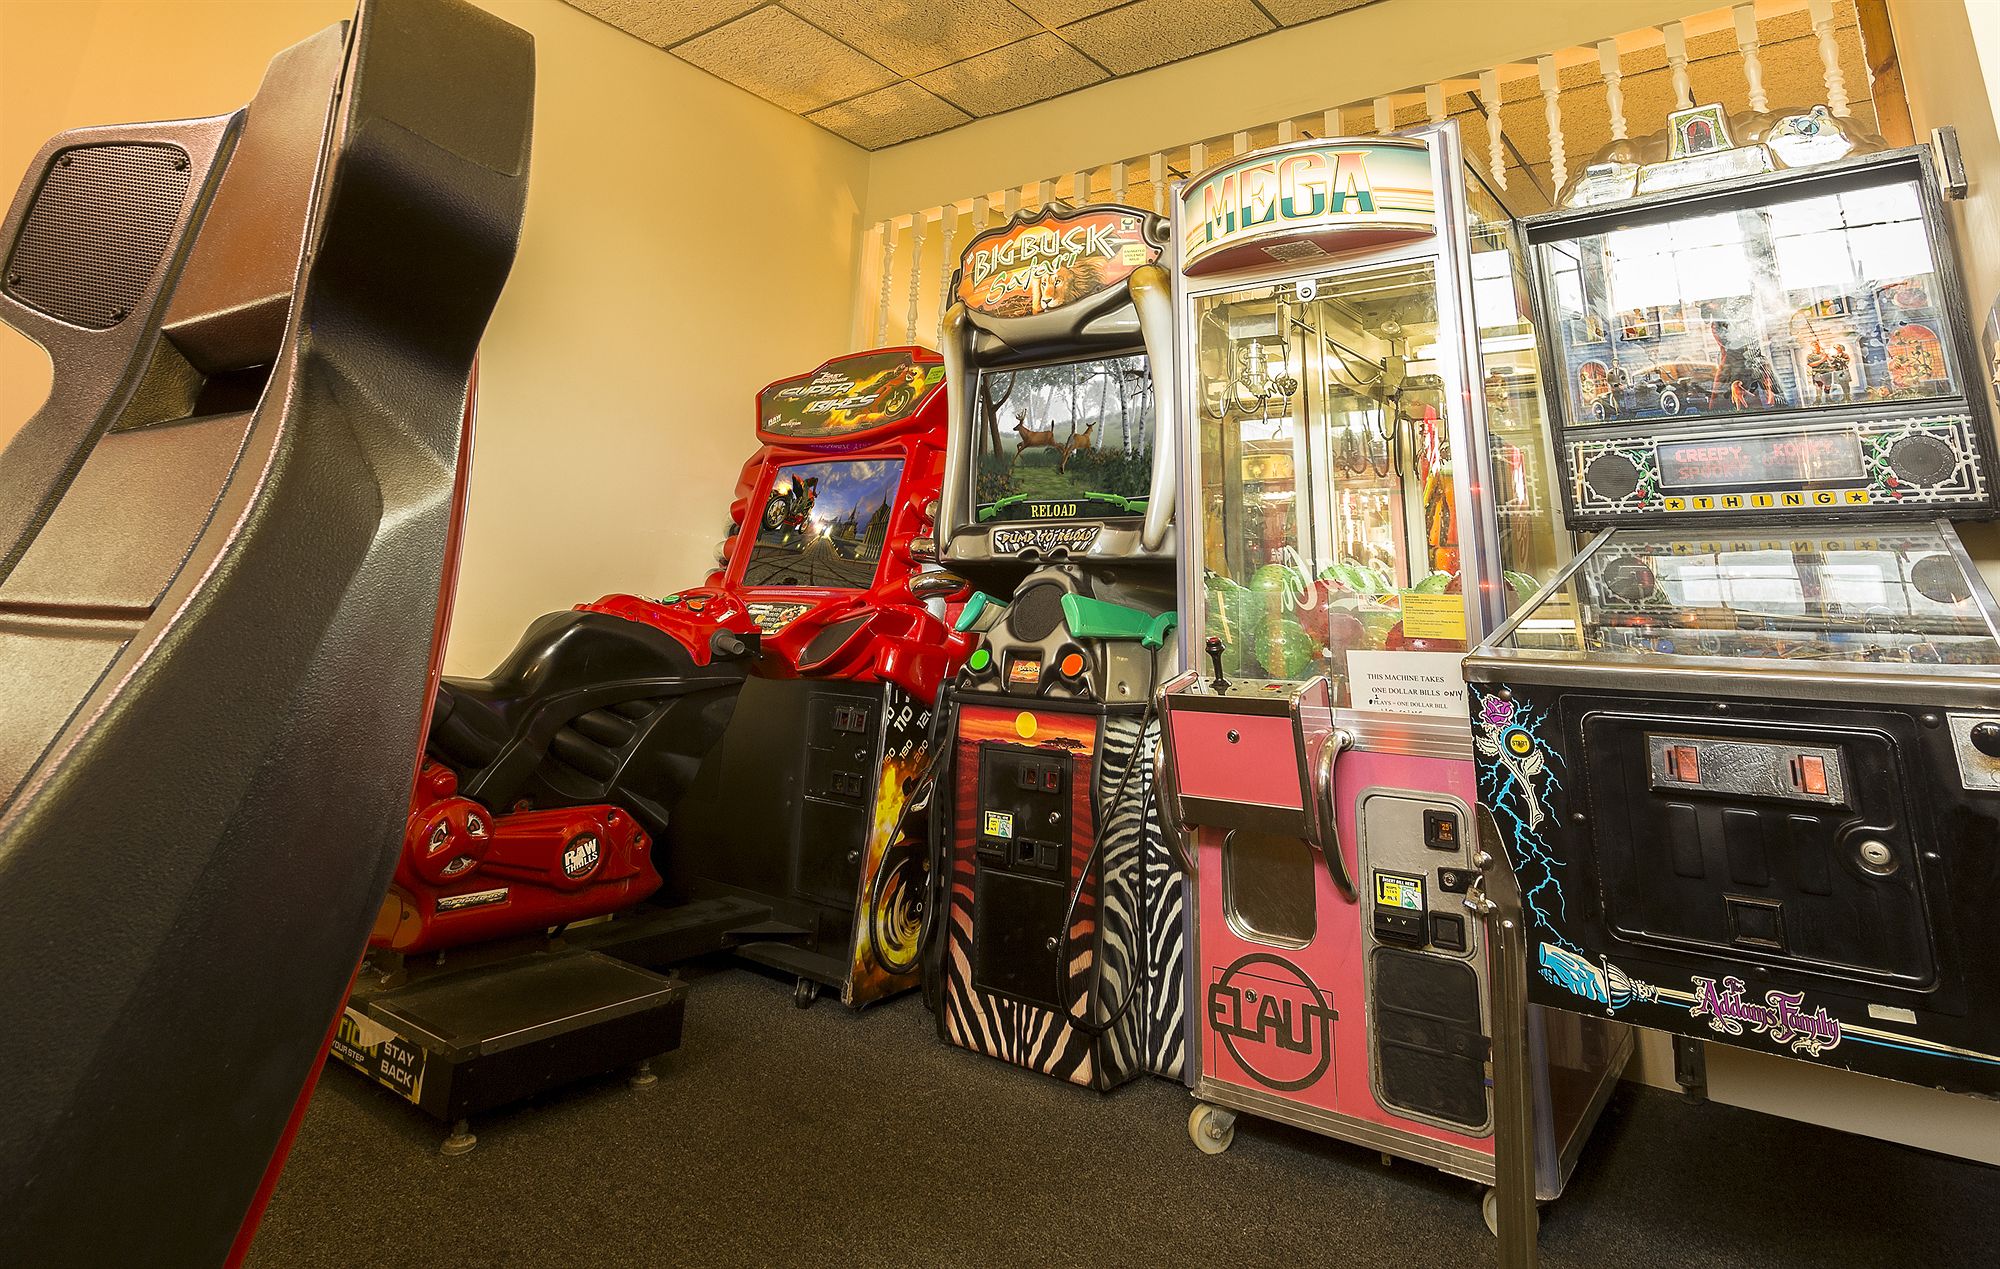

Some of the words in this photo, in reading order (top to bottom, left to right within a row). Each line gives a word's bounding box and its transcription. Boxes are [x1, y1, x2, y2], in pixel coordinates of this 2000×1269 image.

[1203, 150, 1377, 244] MEGA
[973, 239, 1015, 289] BIG
[1020, 223, 1116, 260] BUCK
[986, 251, 1077, 305] Safari
[777, 382, 854, 398] SUPER
[808, 394, 880, 413] BIKES
[1031, 503, 1077, 518] RELOAD
[1384, 674, 1419, 682] MACHINE
[1420, 675, 1445, 683] TAKES
[1388, 687, 1418, 695] DOLLAR
[1419, 689, 1441, 697] BILLS
[893, 705, 913, 732] 110
[899, 739, 913, 759] 180
[913, 740, 928, 763] 200
[564, 838, 597, 867] RAW
[565, 851, 598, 874] THRILLS
[1208, 983, 1339, 1057] ELAUT
[1689, 975, 1777, 1035] Addams
[1765, 990, 1841, 1057] Family
[348, 1050, 365, 1061] STEP
[384, 1041, 415, 1067] STAY
[380, 1060, 412, 1088] BACK
